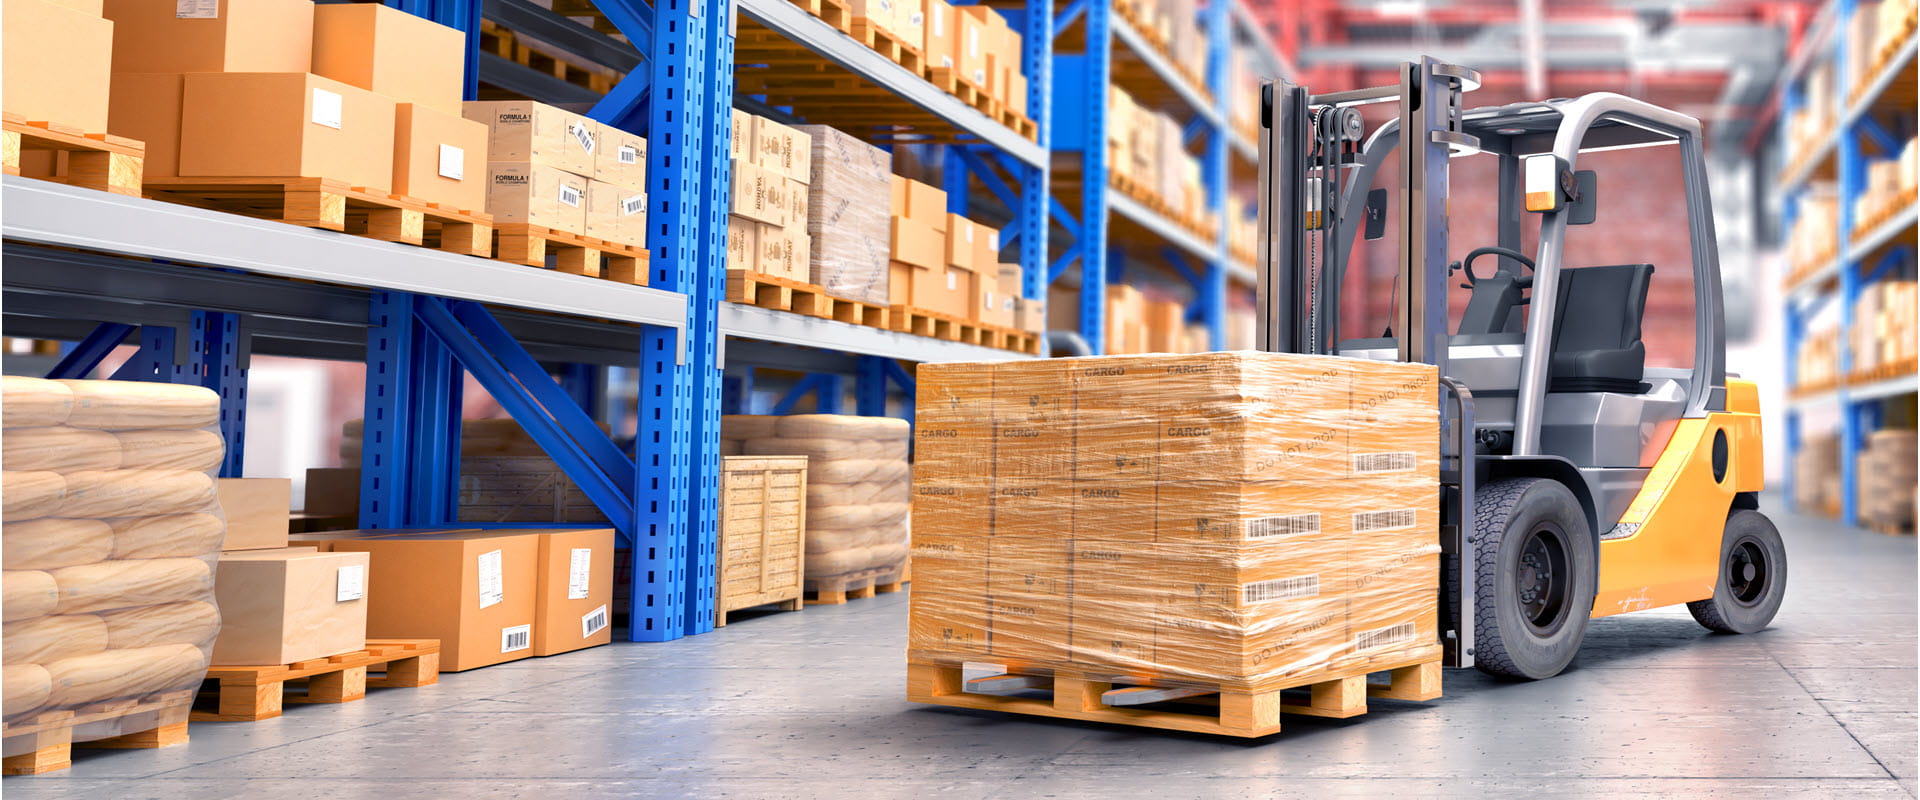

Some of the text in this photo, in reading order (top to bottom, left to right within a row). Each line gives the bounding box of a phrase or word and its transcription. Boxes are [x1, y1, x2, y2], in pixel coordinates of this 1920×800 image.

[1084, 367, 1125, 377] CARGO
[1167, 365, 1208, 374] CARGO
[1361, 375, 1430, 411] DO NOT DROP
[921, 429, 958, 438] CARGO
[1003, 429, 1039, 438] CARGO
[1167, 427, 1211, 437] CARGO
[1256, 429, 1337, 472] DO NOT DROP
[919, 487, 955, 496] CARGO
[1002, 488, 1039, 497] CARGO
[1081, 489, 1120, 498] CARGO
[1356, 575, 1373, 588] DO
[1252, 648, 1271, 666] DO
[1303, 611, 1336, 633] DROP
